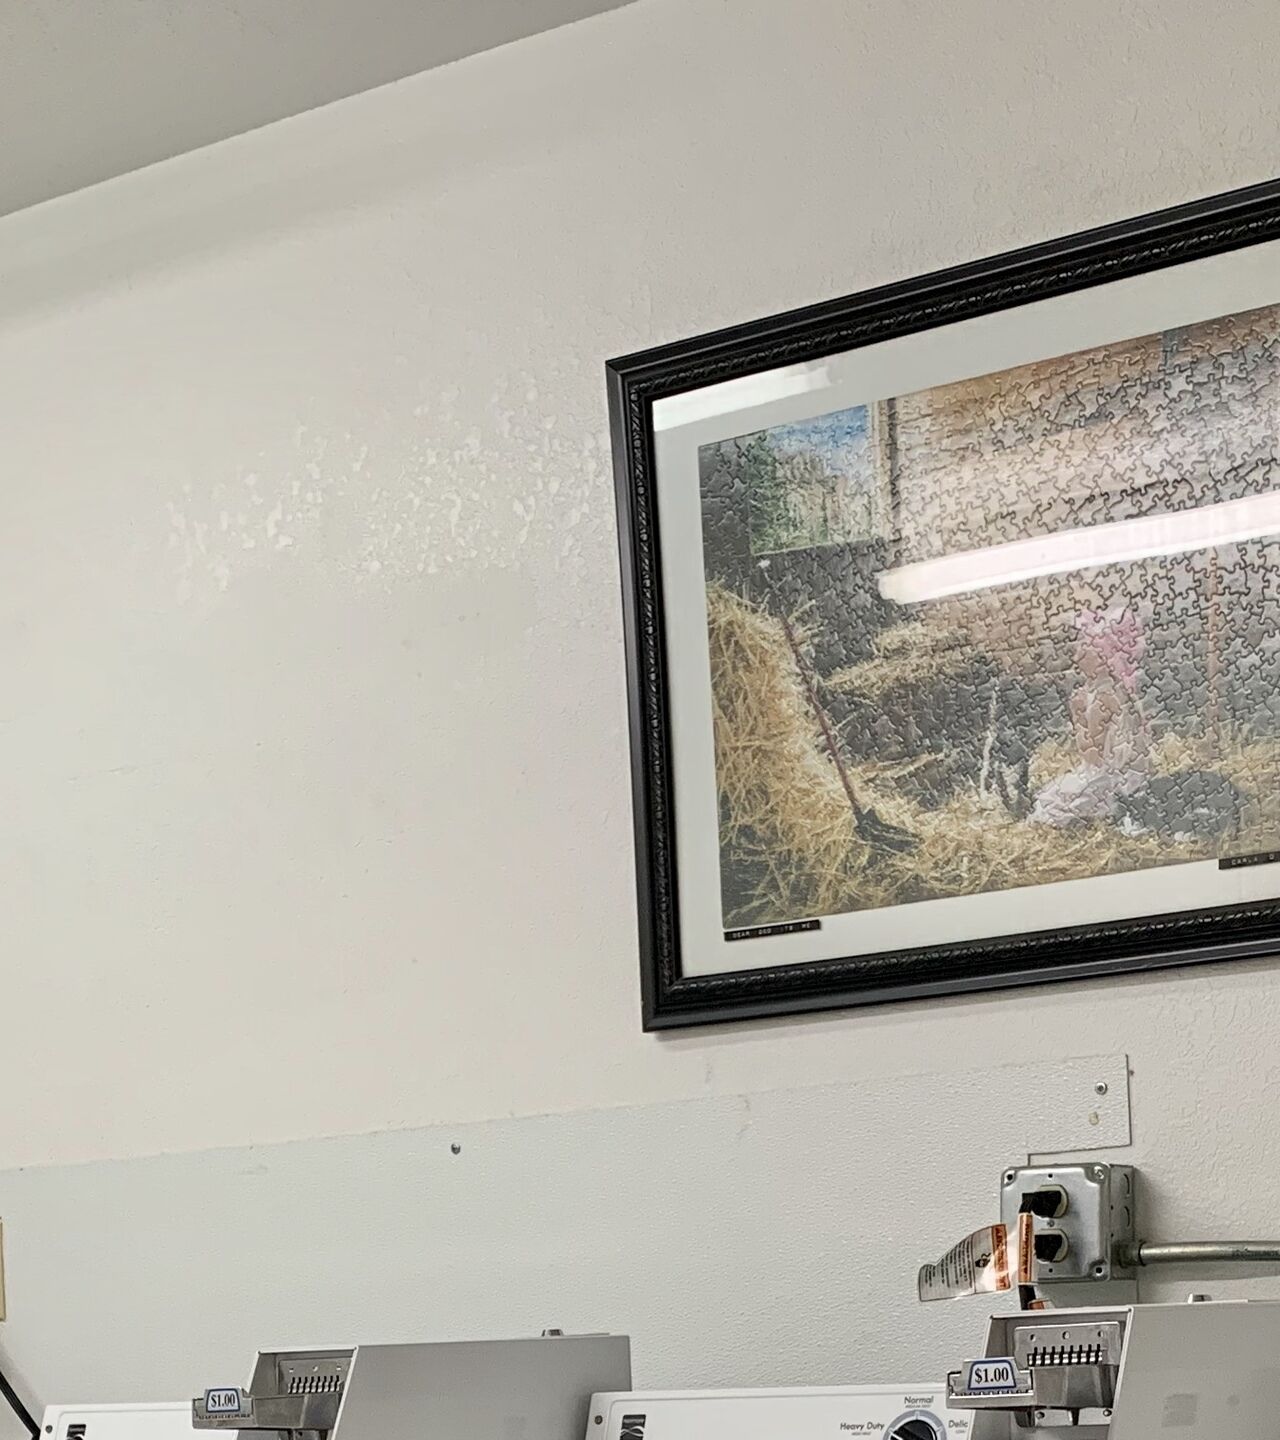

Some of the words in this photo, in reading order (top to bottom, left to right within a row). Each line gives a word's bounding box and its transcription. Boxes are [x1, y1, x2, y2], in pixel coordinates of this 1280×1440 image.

[974, 1367, 1009, 1384] $1.00
[210, 1393, 236, 1408] $1.00
[903, 1396, 934, 1405] Normal
[840, 1422, 865, 1431] Heavy
[866, 1421, 885, 1430] Duty
